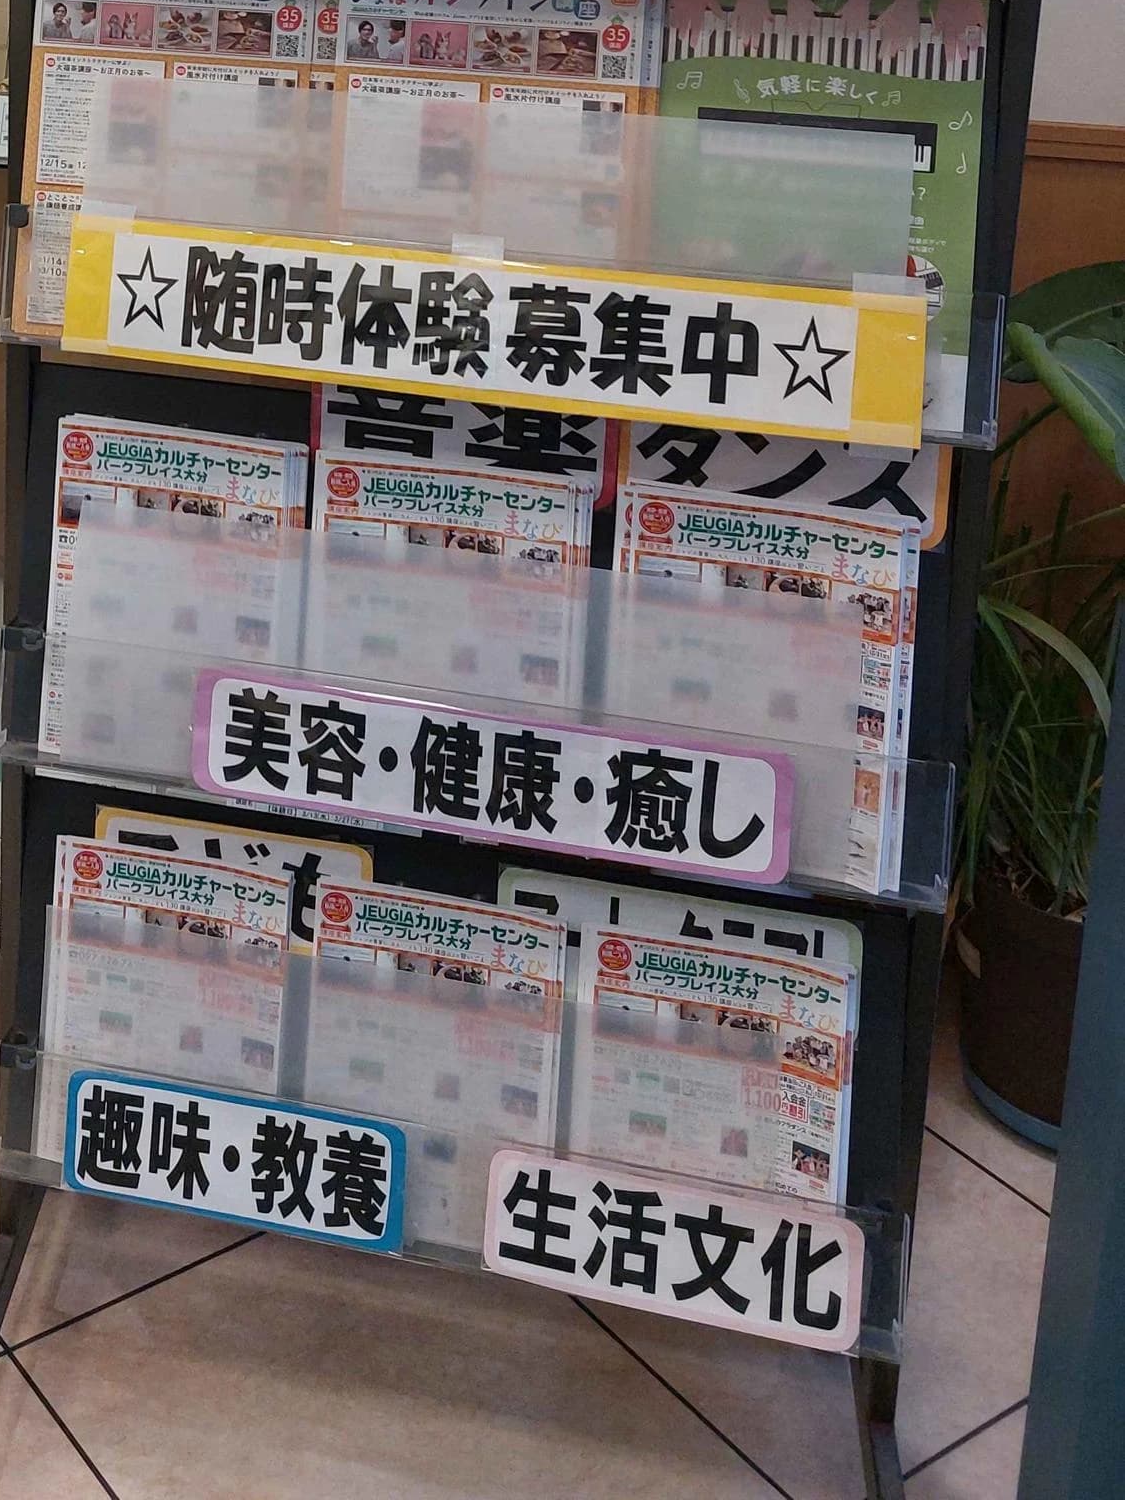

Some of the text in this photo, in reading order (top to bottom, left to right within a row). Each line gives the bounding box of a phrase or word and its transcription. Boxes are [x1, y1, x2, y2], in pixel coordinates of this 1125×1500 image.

[279, 8, 299, 22] 35
[606, 27, 627, 42] 35
[755, 73, 880, 105] 気軽に楽しく
[181, 245, 761, 404] 随時体験募集中
[96, 440, 282, 480] JEUGIAカルチャーセンター
[363, 476, 566, 514] JEUGIAカルチャーセンター
[678, 513, 899, 560] JEUGIAカルチャーセンター
[221, 687, 767, 861] 美容・健康・癒し
[106, 861, 286, 907] JEUGIAカルチャーセンター
[355, 902, 550, 950] JEUGIAカルチャーセンター
[635, 950, 842, 1004] JEUGIAカルチャーセンター
[76, 1083, 389, 1238] 趣味・教養
[498, 1167, 844, 1333] 生活文化
